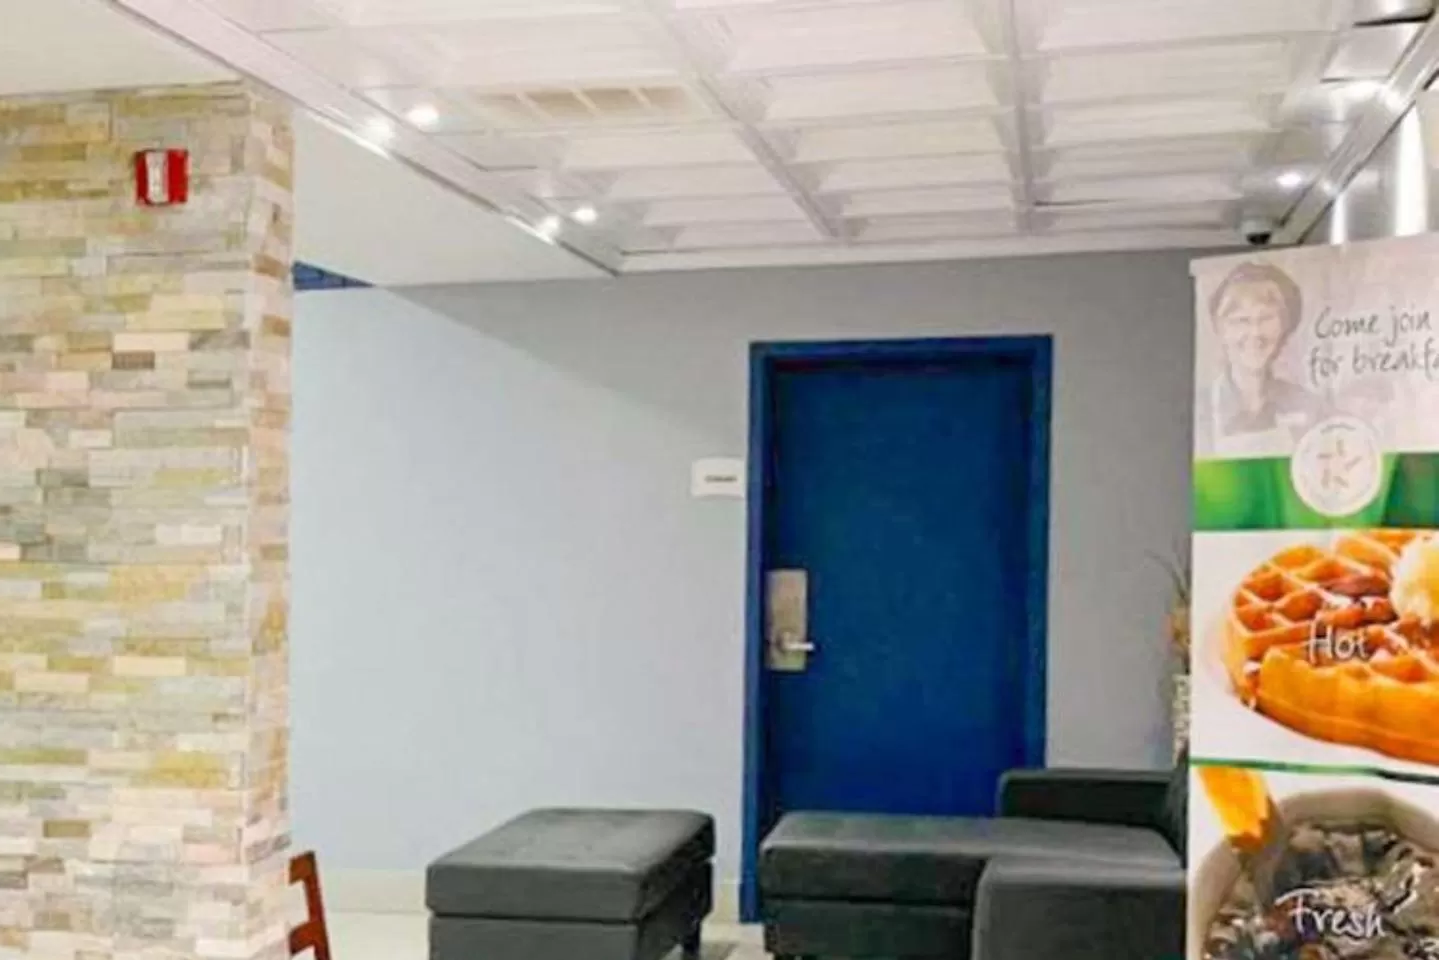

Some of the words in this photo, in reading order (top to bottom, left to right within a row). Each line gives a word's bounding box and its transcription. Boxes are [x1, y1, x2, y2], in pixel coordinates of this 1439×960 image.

[1314, 305, 1381, 339] Come
[1383, 304, 1433, 349] join
[1308, 345, 1344, 389] for
[1308, 623, 1372, 667] Hot
[1274, 888, 1386, 939] Fresh
